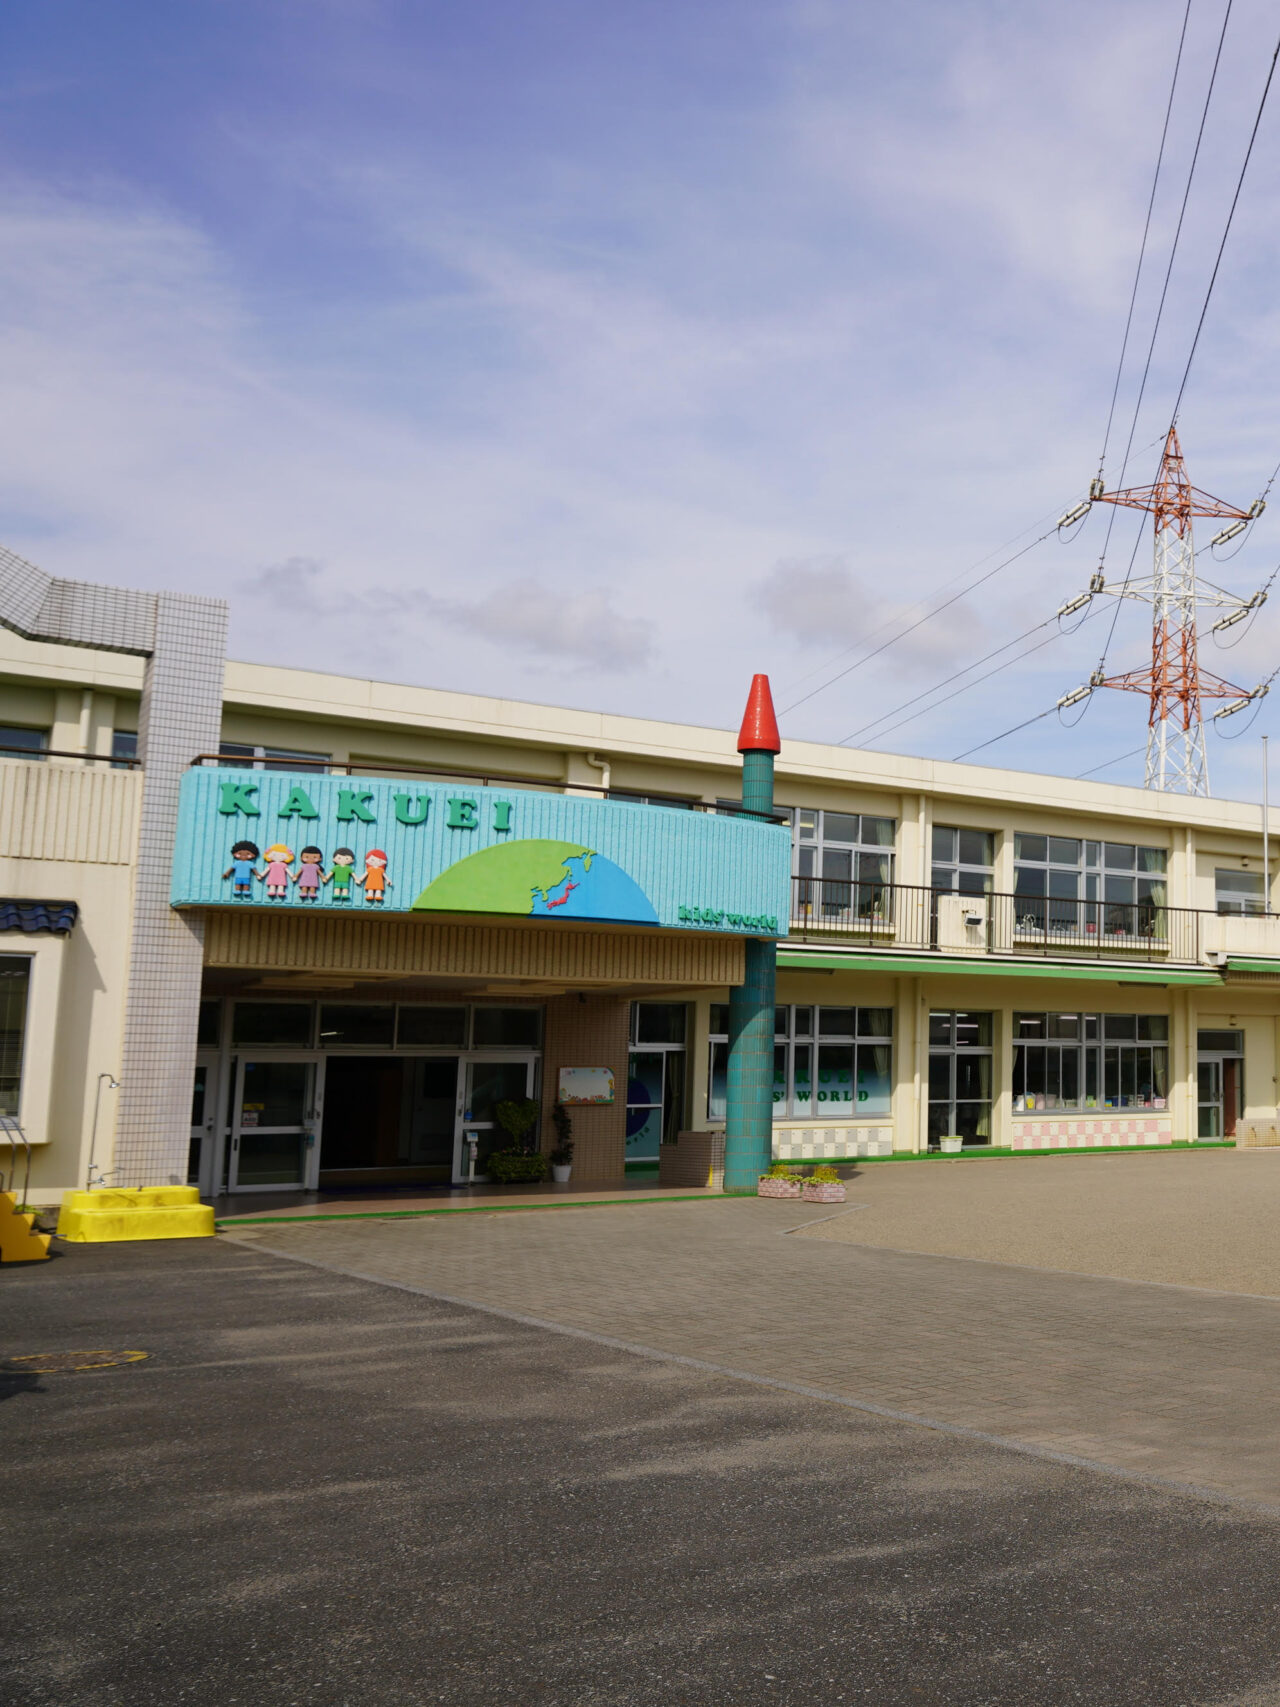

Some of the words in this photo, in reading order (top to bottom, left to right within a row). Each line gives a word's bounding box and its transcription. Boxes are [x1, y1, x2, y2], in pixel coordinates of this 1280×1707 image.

[218, 782, 513, 831] KAKUEI
[726, 913, 778, 930] world
[773, 1069, 865, 1083] AKUEI
[796, 1091, 869, 1102] WORLD
